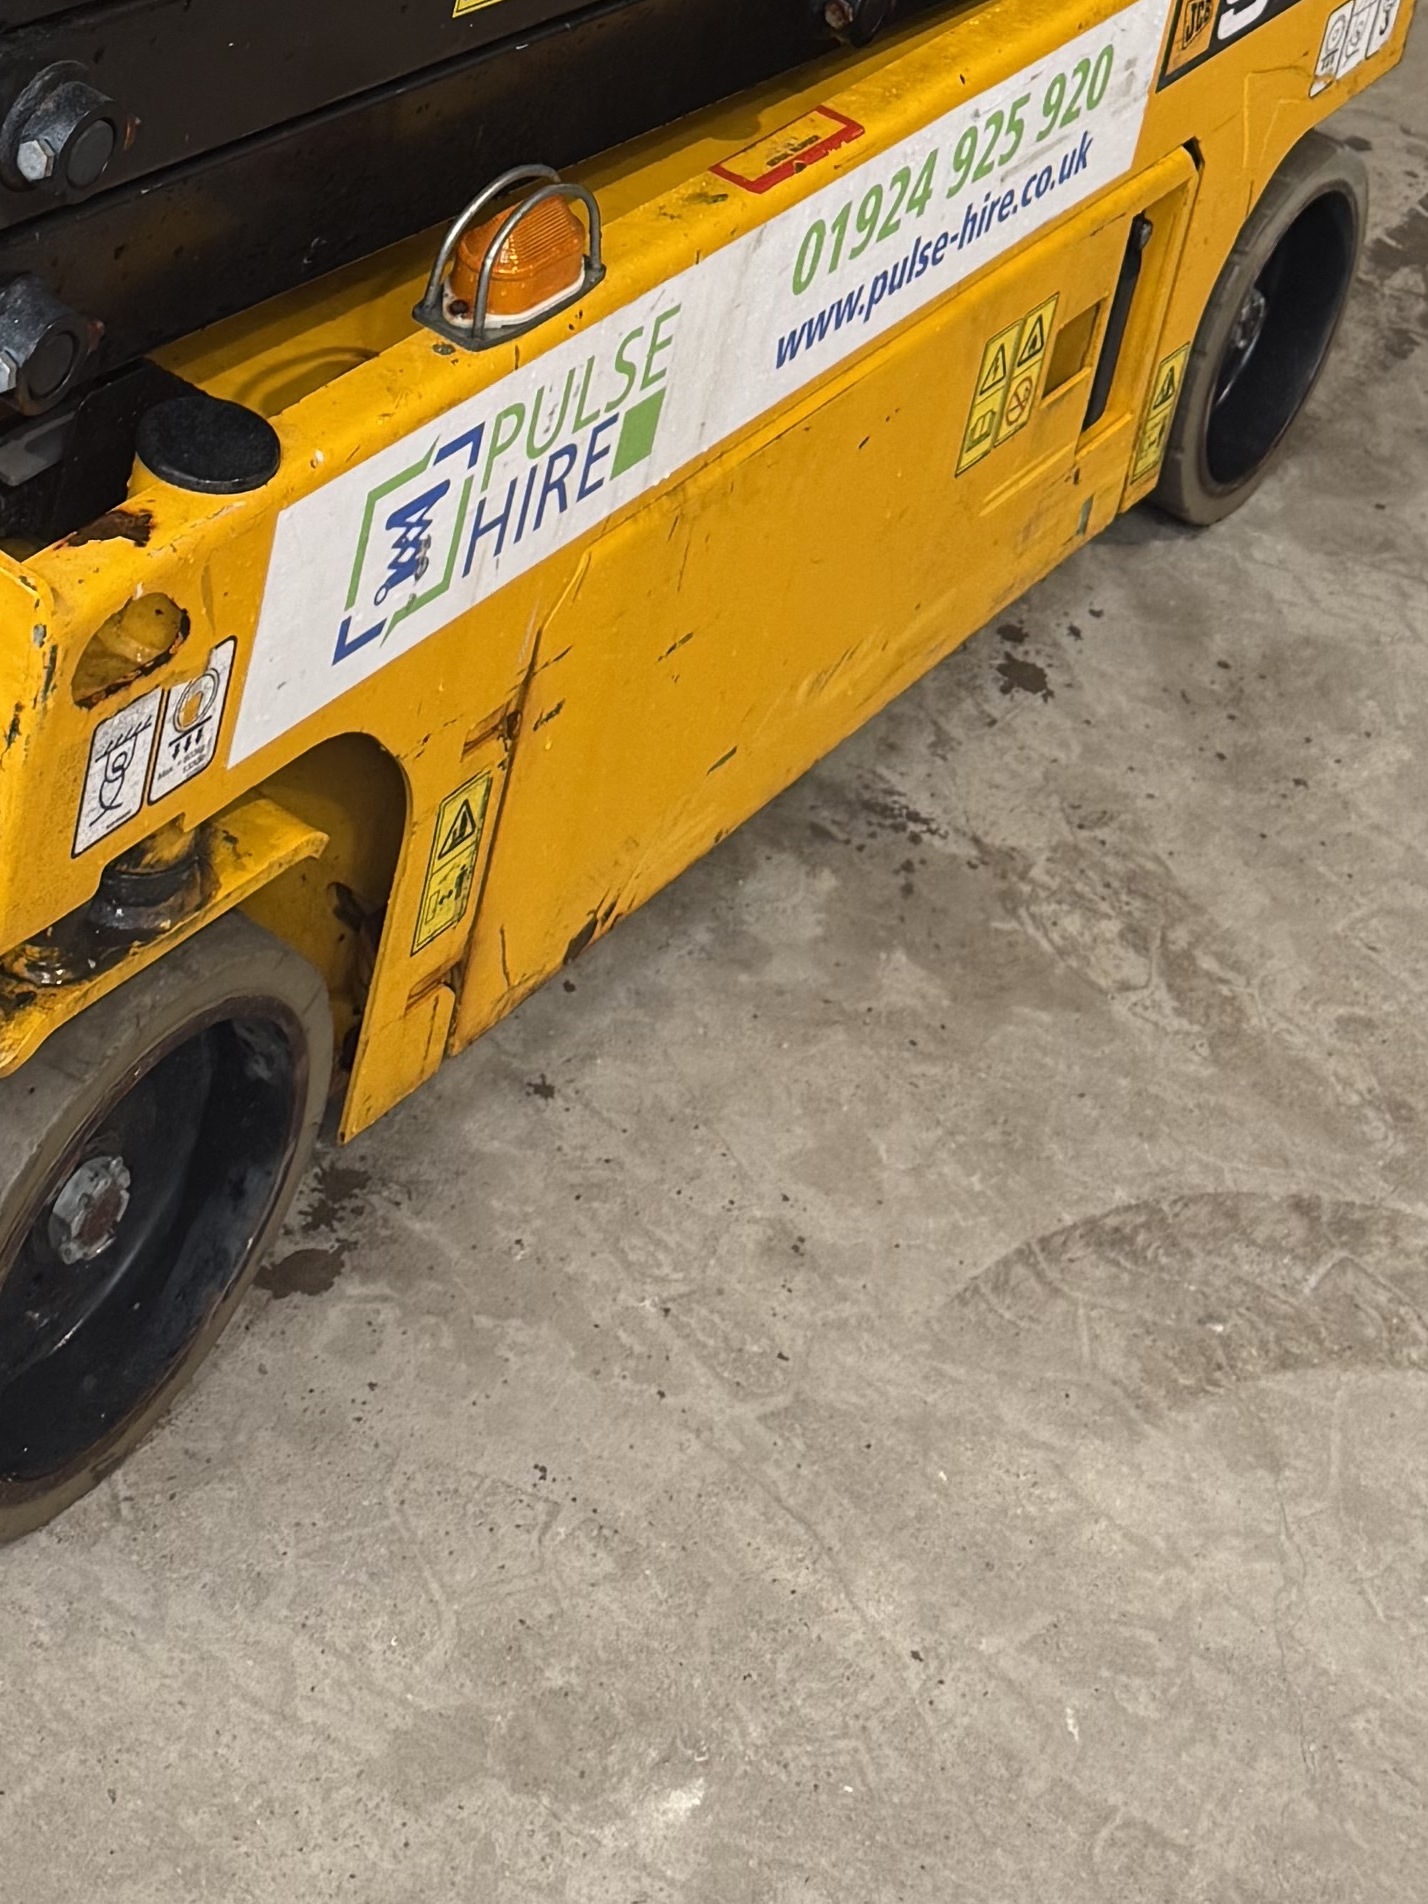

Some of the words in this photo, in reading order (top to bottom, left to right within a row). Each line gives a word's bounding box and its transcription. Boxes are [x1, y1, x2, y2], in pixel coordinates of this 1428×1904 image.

[776, 130, 1093, 370] www.pulse-hire.co.uk
[792, 147, 939, 296] 01924
[946, 92, 1031, 200] 925
[1035, 44, 1114, 143] 920
[462, 412, 620, 578] HIRE
[480, 303, 682, 493] PULSE
